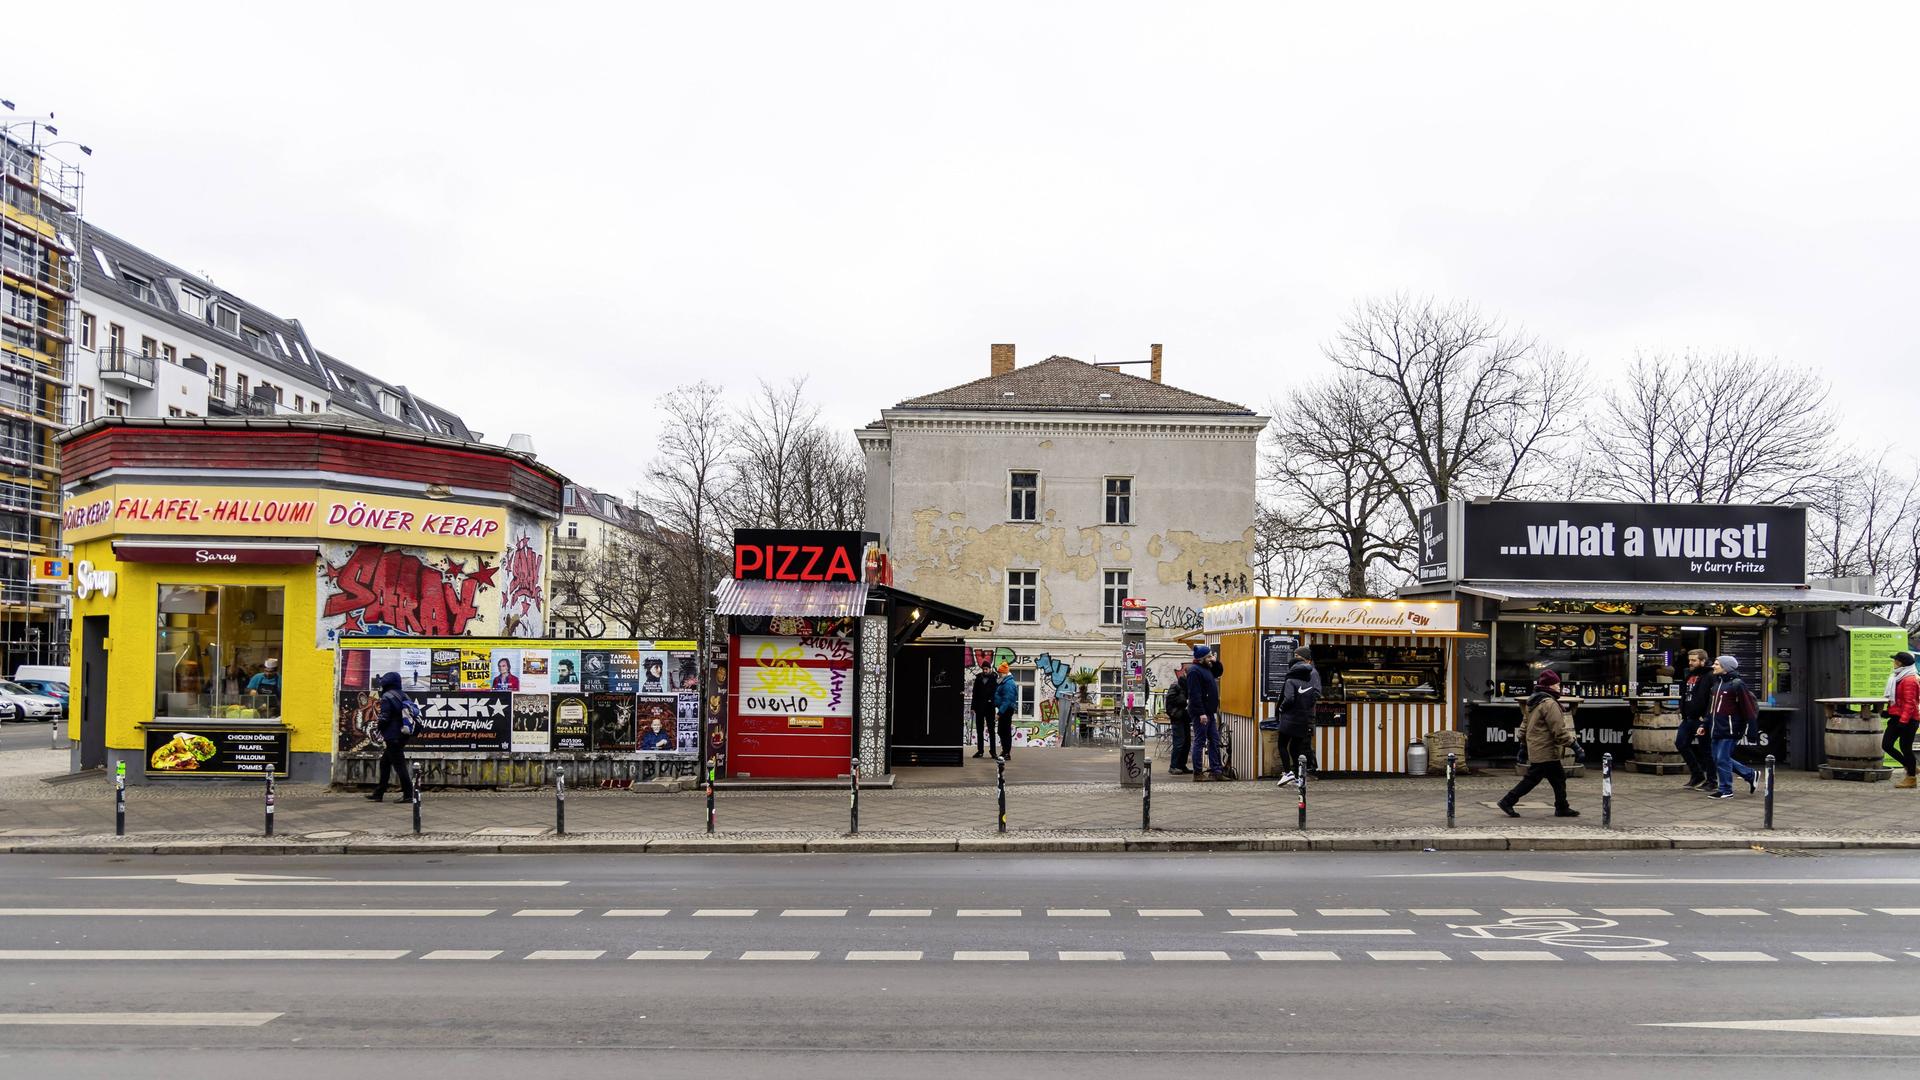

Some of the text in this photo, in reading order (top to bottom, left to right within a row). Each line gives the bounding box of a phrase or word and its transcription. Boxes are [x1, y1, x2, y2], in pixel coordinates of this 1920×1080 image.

[86, 500, 112, 524] KEBAP
[328, 501, 499, 539] DÖNER KEBAP
[1624, 526, 1644, 557] a
[1652, 523, 1768, 559] wurst!
[195, 549, 237, 563] Saray
[734, 544, 857, 582] PIZZA
[1691, 561, 1766, 573] by Curry Fritze
[78, 560, 117, 599] Saray
[324, 544, 477, 635] SARAY
[1407, 610, 1430, 626] raw
[462, 661, 490, 671] BALKAN
[467, 671, 490, 681] BEATS
[425, 697, 490, 718] ZSK
[450, 719, 494, 731] HOFFNUNG
[1599, 728, 1623, 744] Uhr
